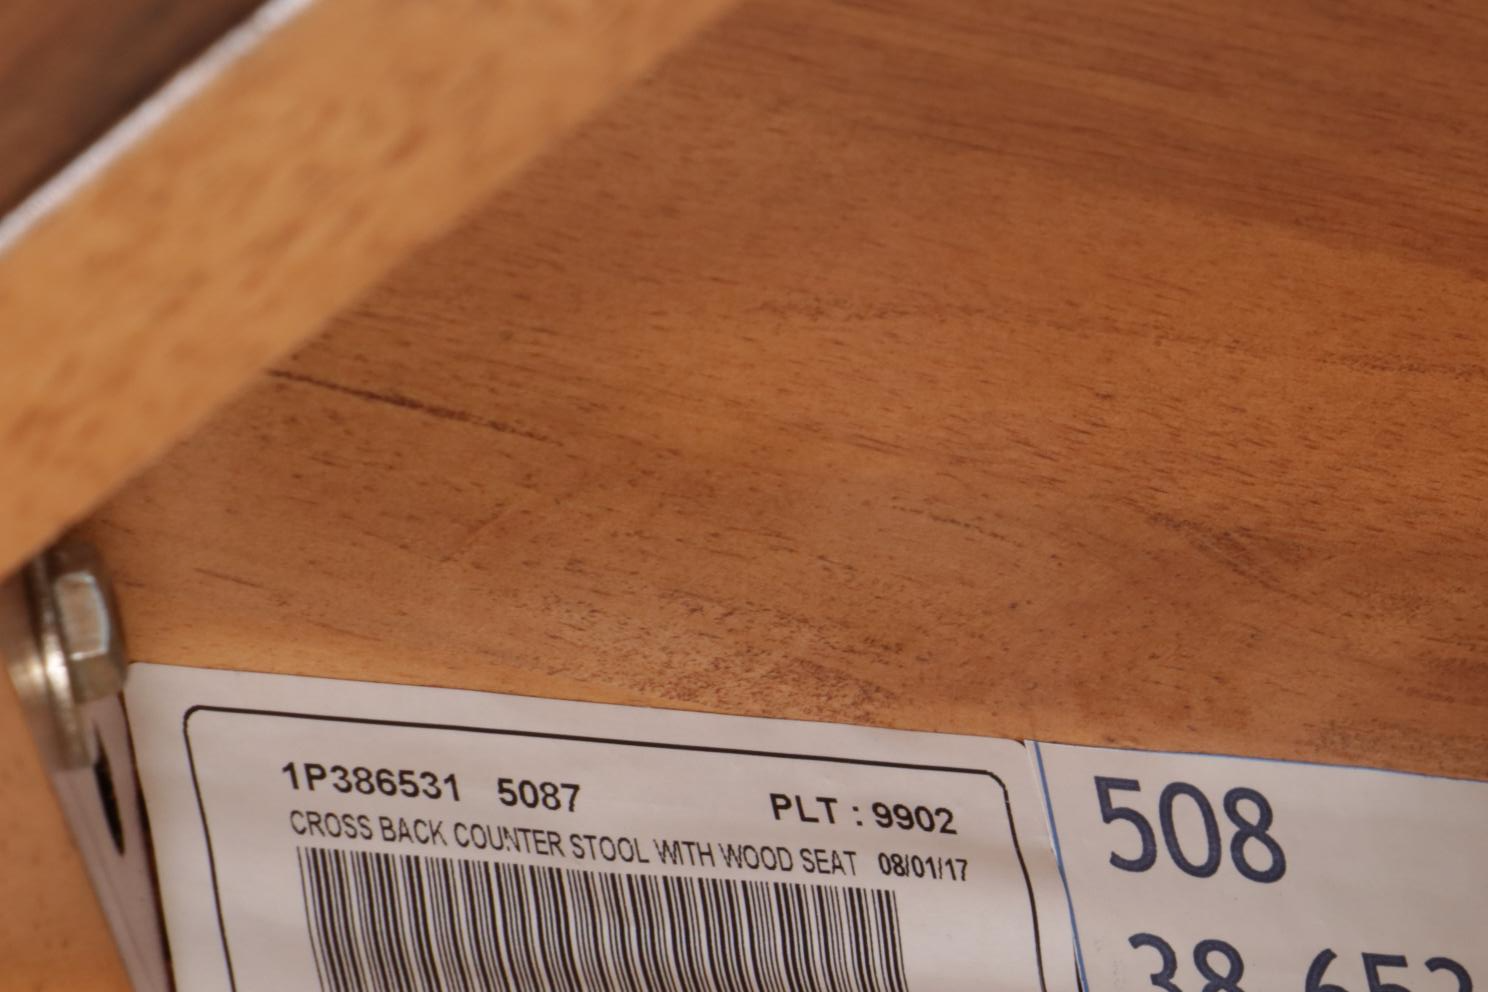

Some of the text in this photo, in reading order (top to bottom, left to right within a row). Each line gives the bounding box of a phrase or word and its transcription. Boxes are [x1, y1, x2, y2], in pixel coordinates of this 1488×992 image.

[281, 761, 581, 813] 1P386531 5087
[769, 792, 838, 825] PLT
[871, 801, 958, 835] 9902
[289, 808, 969, 882] CROSS BACK COUNTER STOOL WITH WOOD SEAT 08/01/17
[1093, 774, 1288, 885] 508
